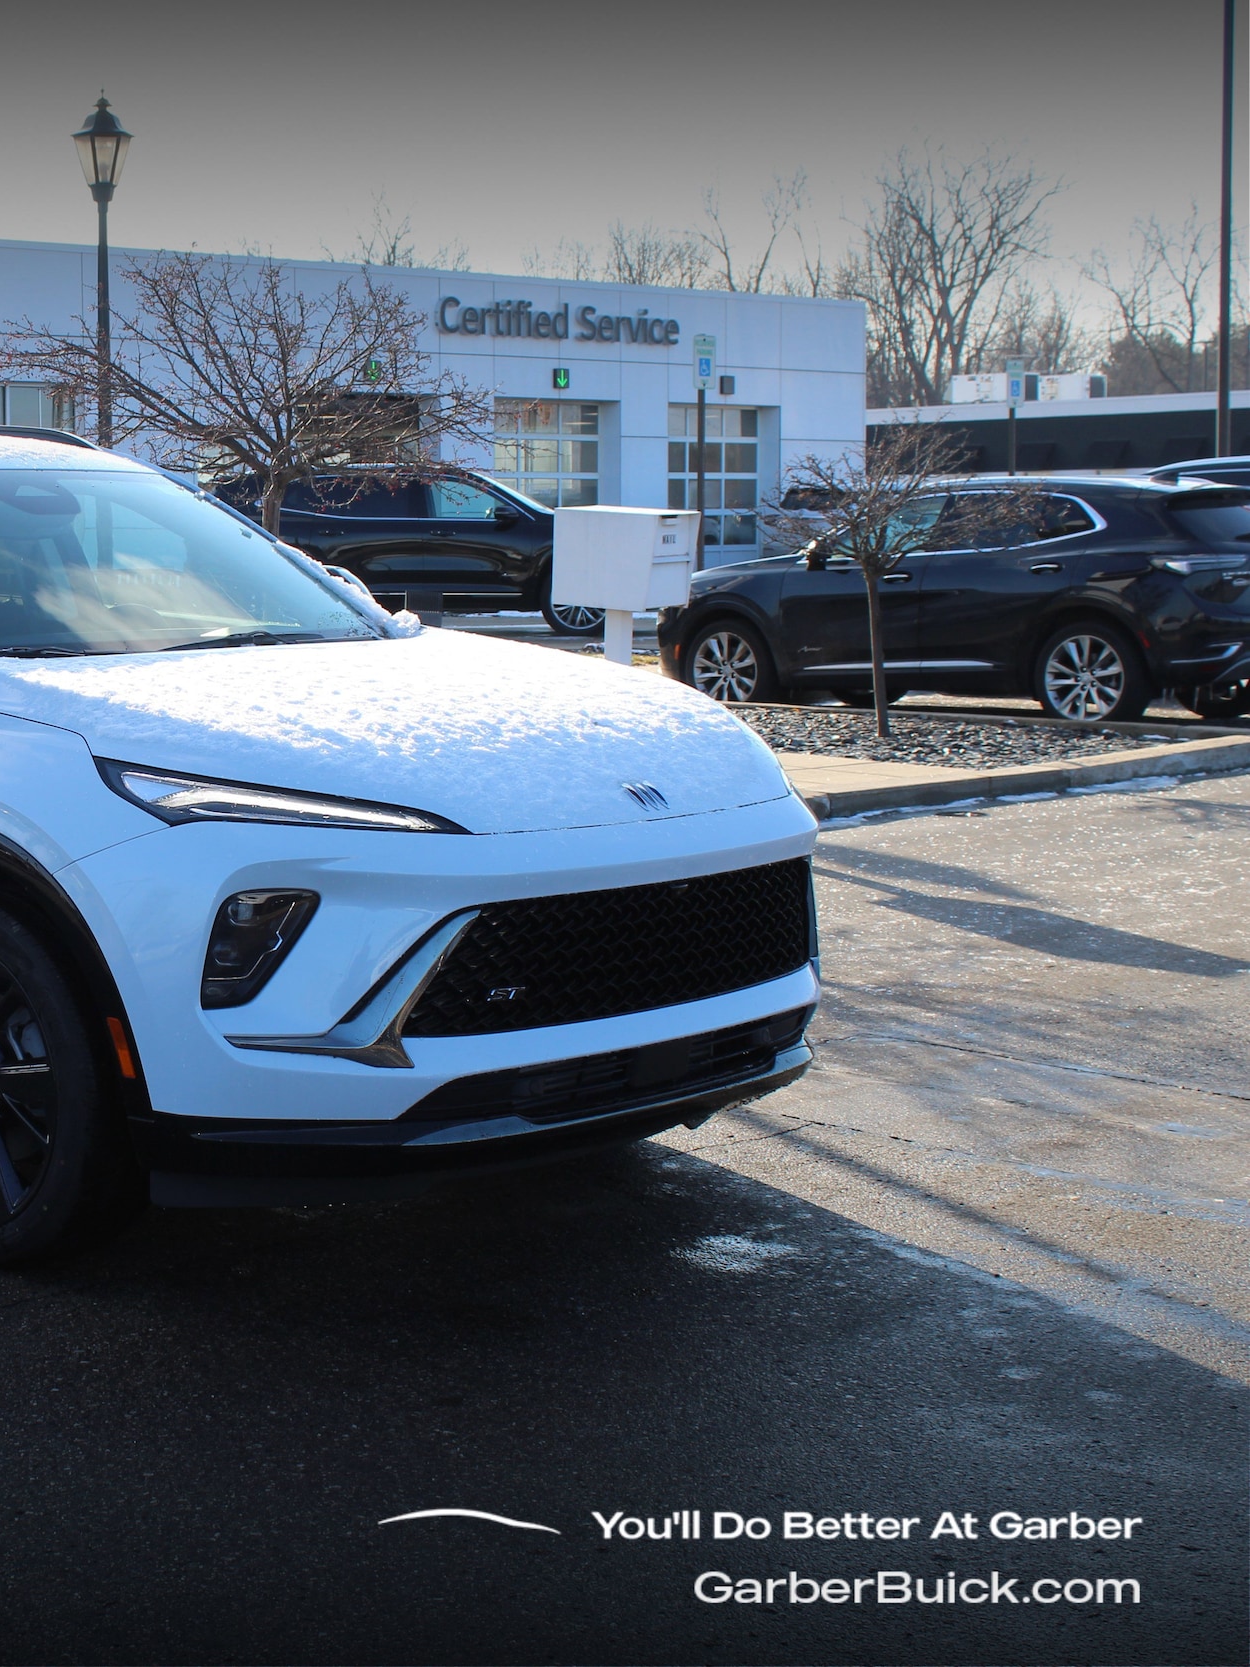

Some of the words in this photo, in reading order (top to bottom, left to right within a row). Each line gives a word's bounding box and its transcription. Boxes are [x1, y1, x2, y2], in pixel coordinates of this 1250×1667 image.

[435, 296, 569, 340] Certified
[575, 306, 680, 345] Service
[487, 986, 526, 1002] ST
